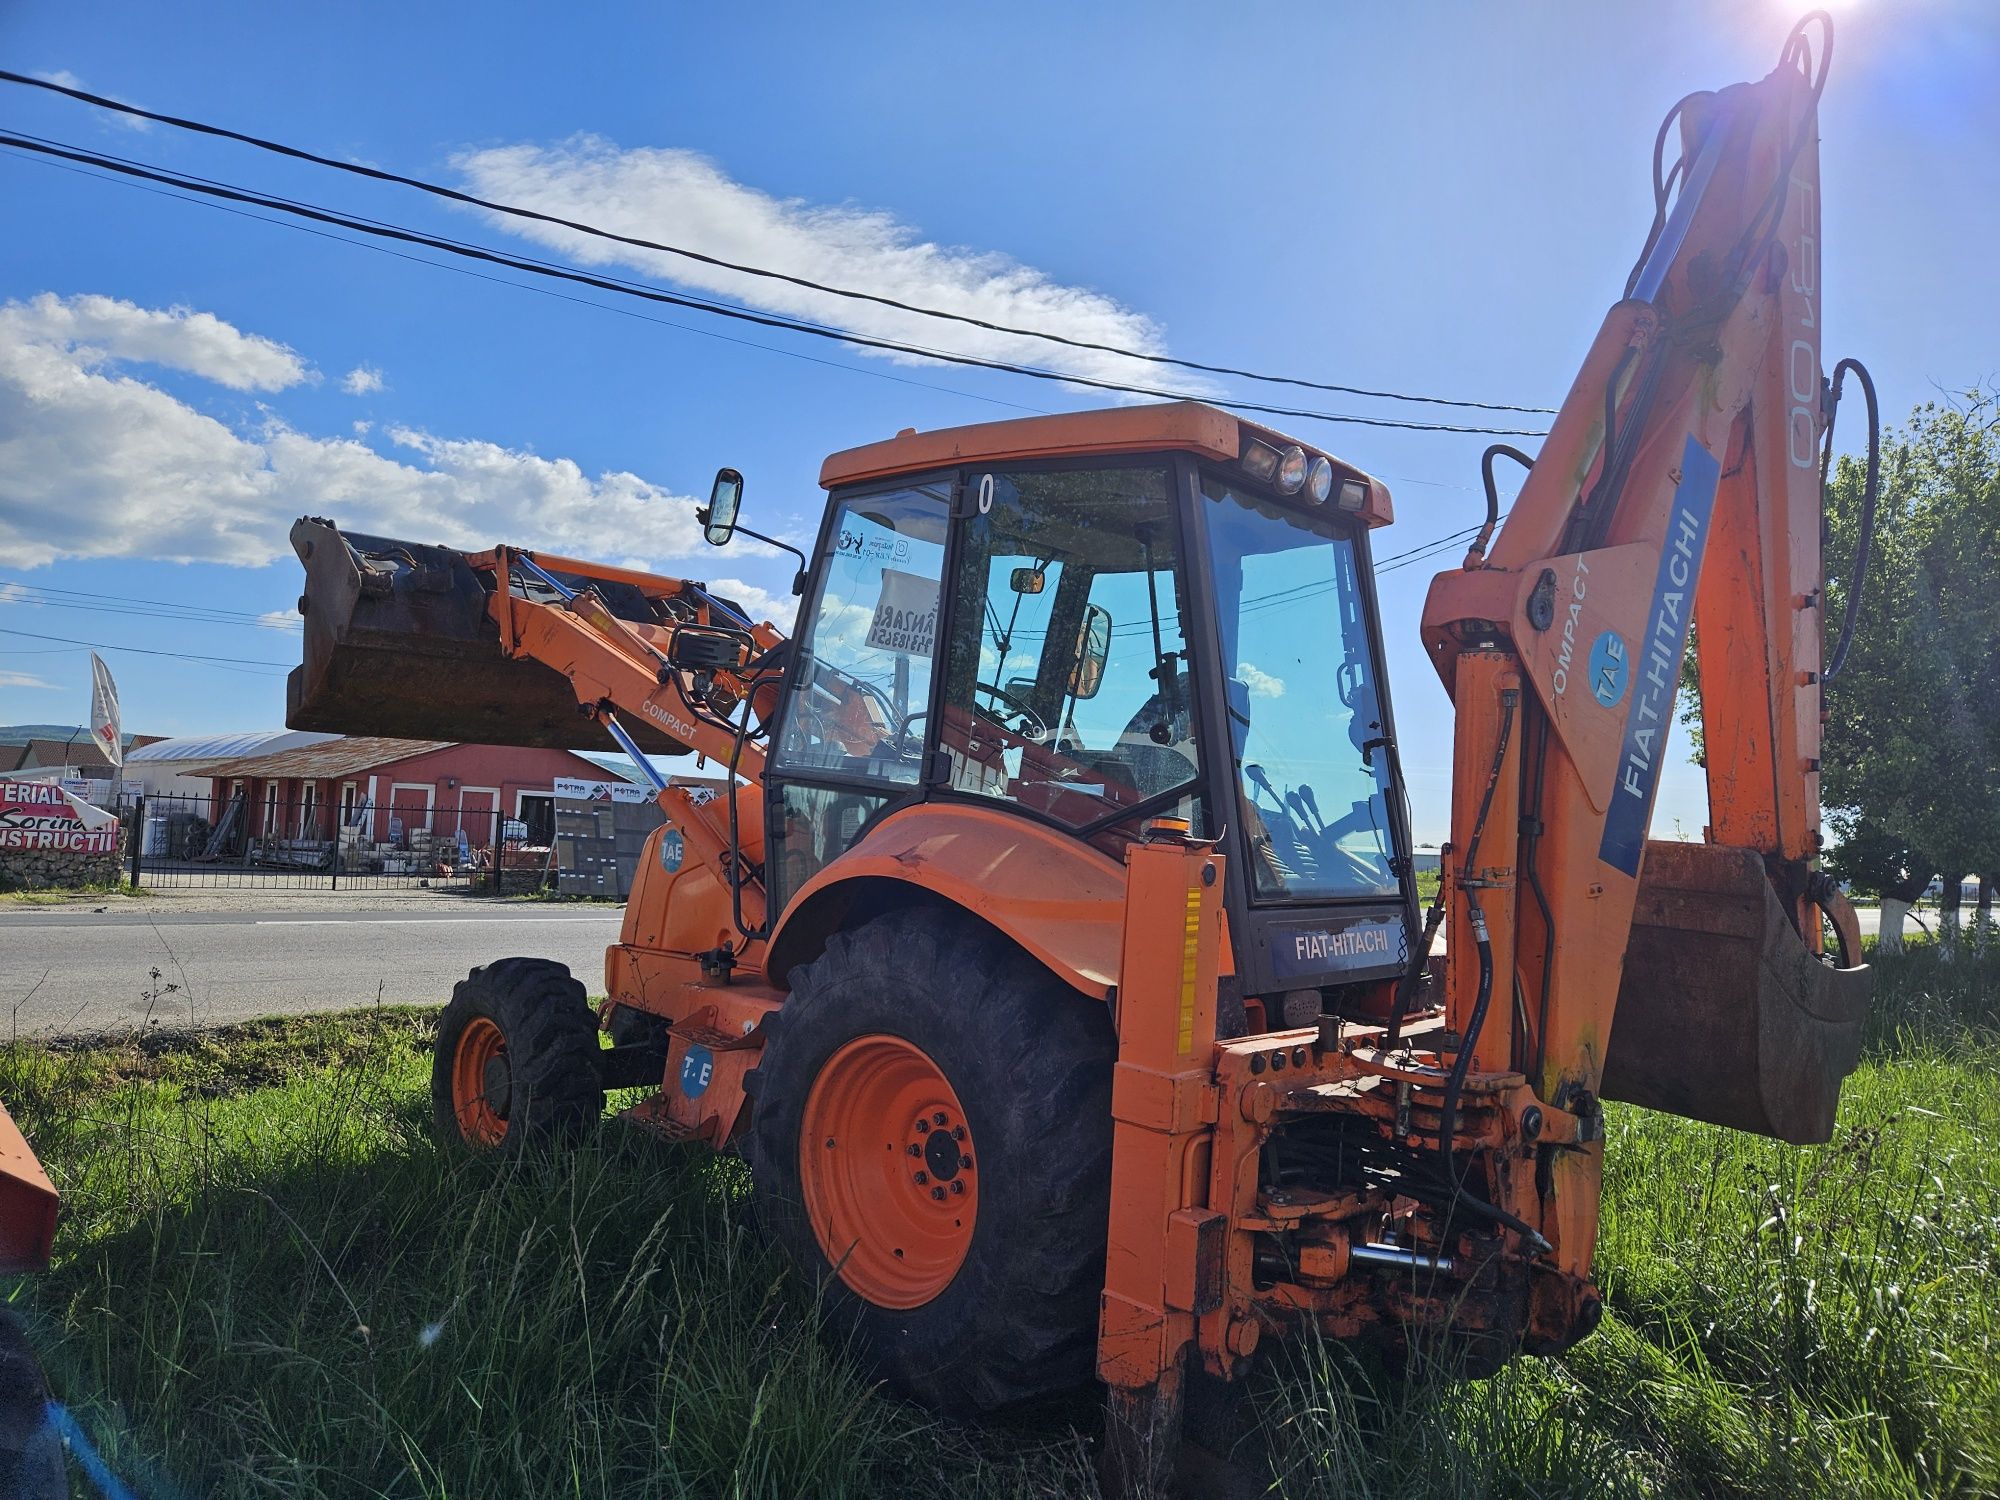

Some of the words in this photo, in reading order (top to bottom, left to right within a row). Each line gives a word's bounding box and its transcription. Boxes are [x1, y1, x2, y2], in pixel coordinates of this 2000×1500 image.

[978, 473, 994, 515] 0
[1550, 552, 1591, 702] OMPACT
[1594, 634, 1625, 703] TAE
[1622, 507, 1700, 800] FIAT-HITACHI
[642, 700, 697, 740] COMPACT
[0, 783, 70, 805] ERIAL
[661, 842, 683, 861] TAE
[1295, 929, 1389, 960] FIAT-HITACHI
[683, 1055, 713, 1087] TE
